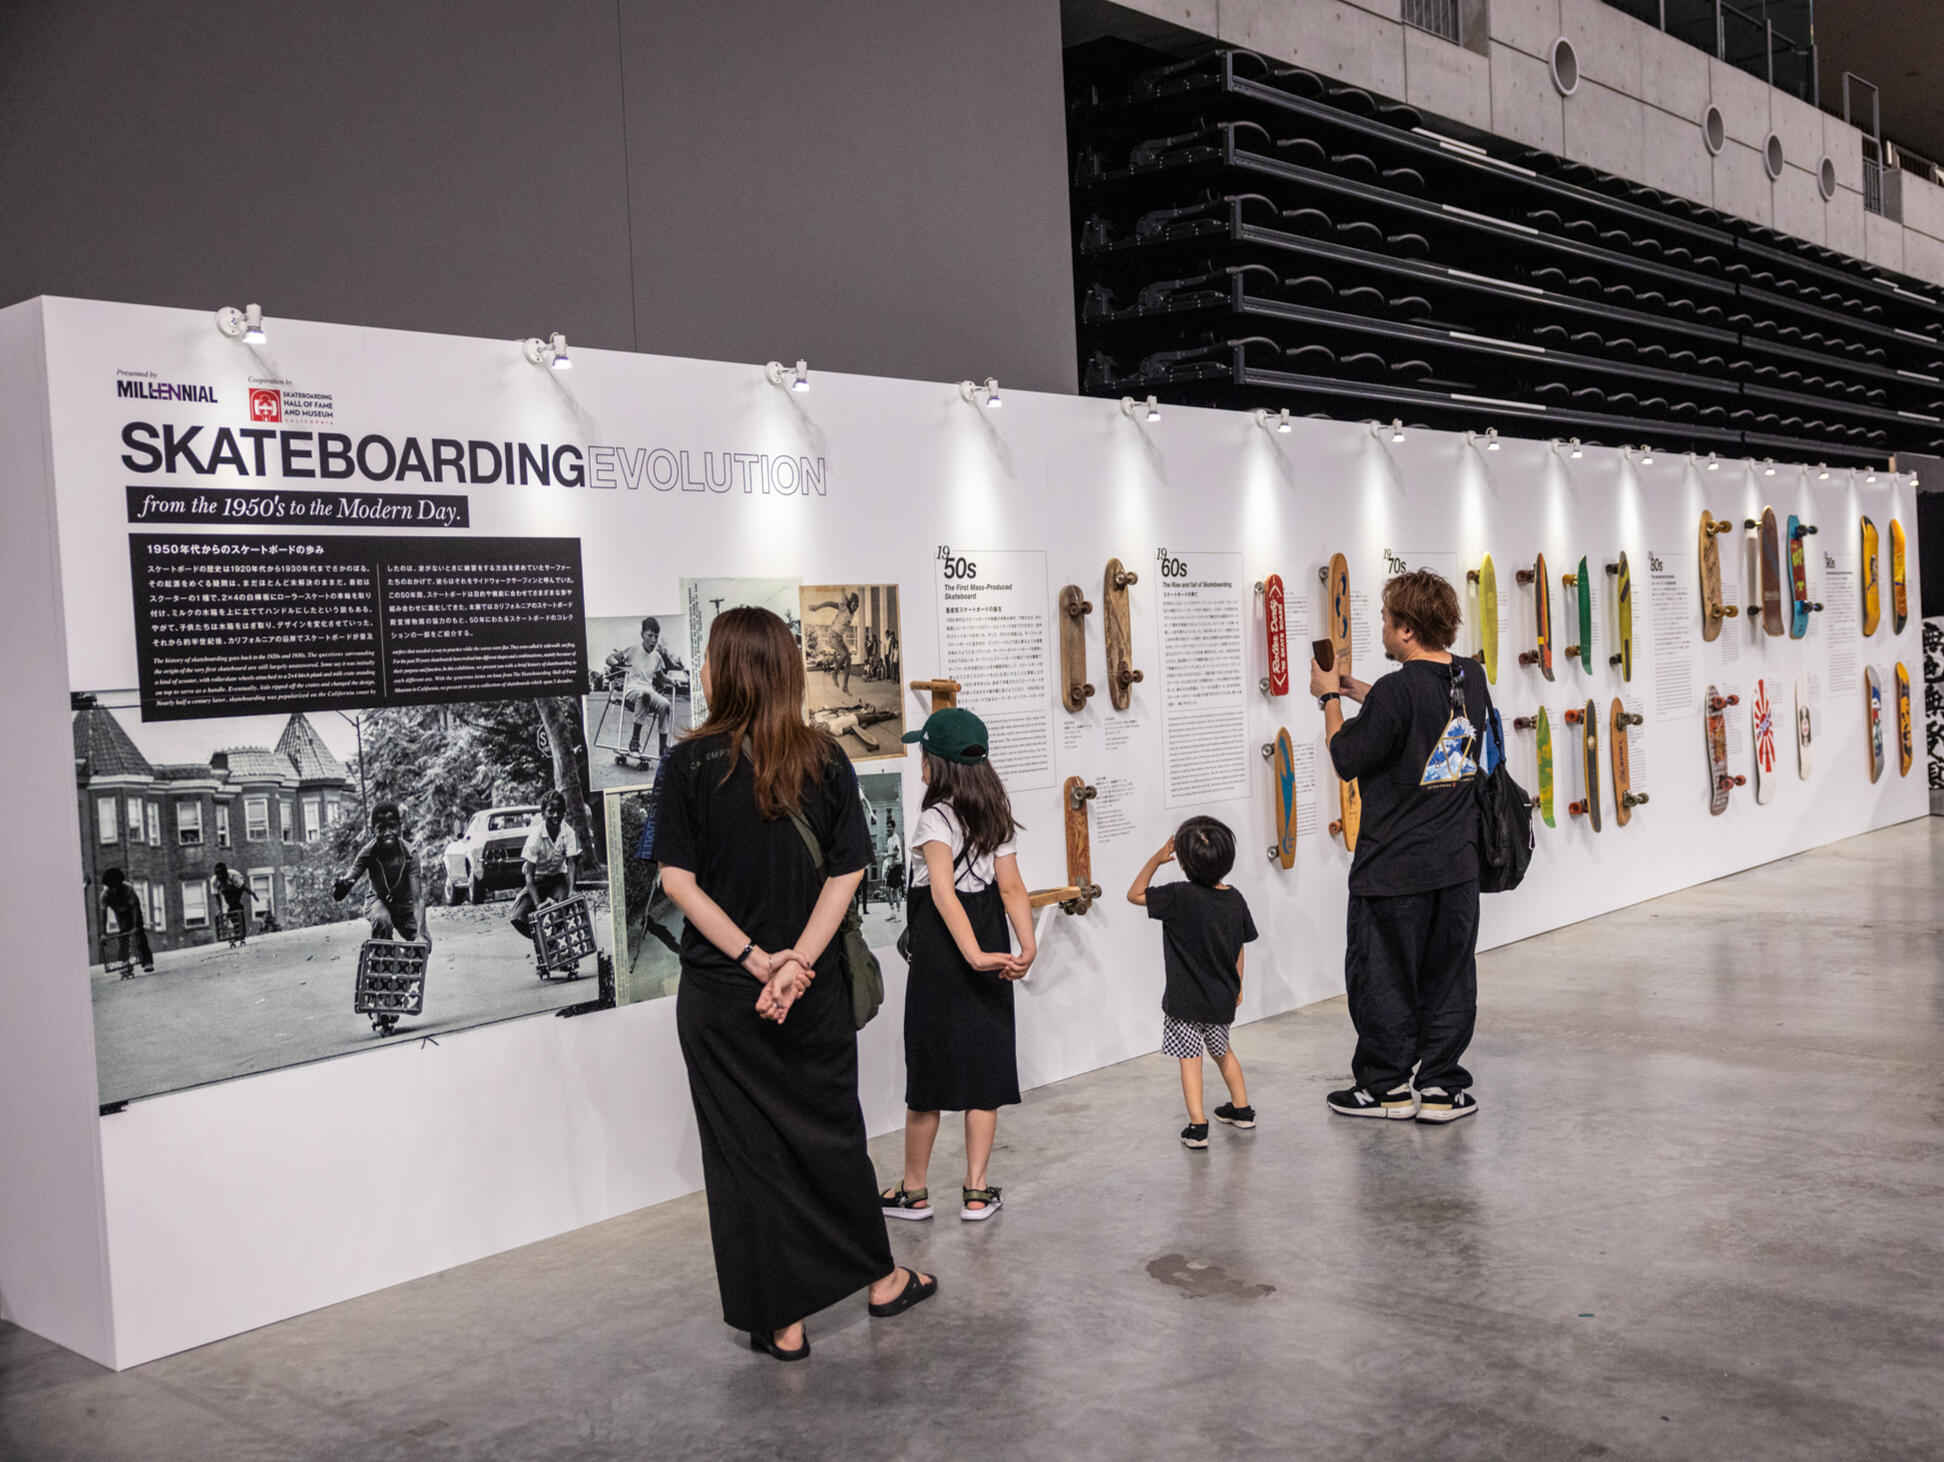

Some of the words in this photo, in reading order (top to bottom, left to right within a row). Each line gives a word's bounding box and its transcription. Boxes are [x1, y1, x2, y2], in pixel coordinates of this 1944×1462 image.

[116, 369, 147, 377] Presented
[248, 376, 282, 386] Cooperation
[282, 378, 293, 386] by
[117, 380, 218, 403] MILLENNIAL
[283, 391, 332, 400] SKATEBOARDING
[283, 400, 302, 408] HALL
[303, 401, 313, 409] OF
[314, 402, 333, 410] FAME
[284, 409, 301, 417] AND
[302, 410, 334, 418] MUSEUM
[121, 421, 586, 488] SKATEBOARDING
[588, 445, 828, 496] EVOLUTION
[138, 494, 186, 519] from
[191, 496, 218, 515] the
[221, 495, 285, 518] 1950's
[289, 500, 305, 516] to
[309, 497, 333, 517] the
[336, 497, 413, 520] Modern
[416, 500, 461, 528] Day.
[147, 544, 324, 555] 1950年代からのスケートボードの歩み
[1157, 548, 1168, 560] 19
[936, 545, 950, 560] 19
[944, 557, 977, 579] 50s
[1161, 558, 1187, 577] 60s
[1384, 548, 1392, 560] 19
[1388, 557, 1407, 574] 70s
[970, 583, 1012, 591] Mass-Produced
[1269, 598, 1279, 632] Derby
[1271, 635, 1281, 673] Roller
